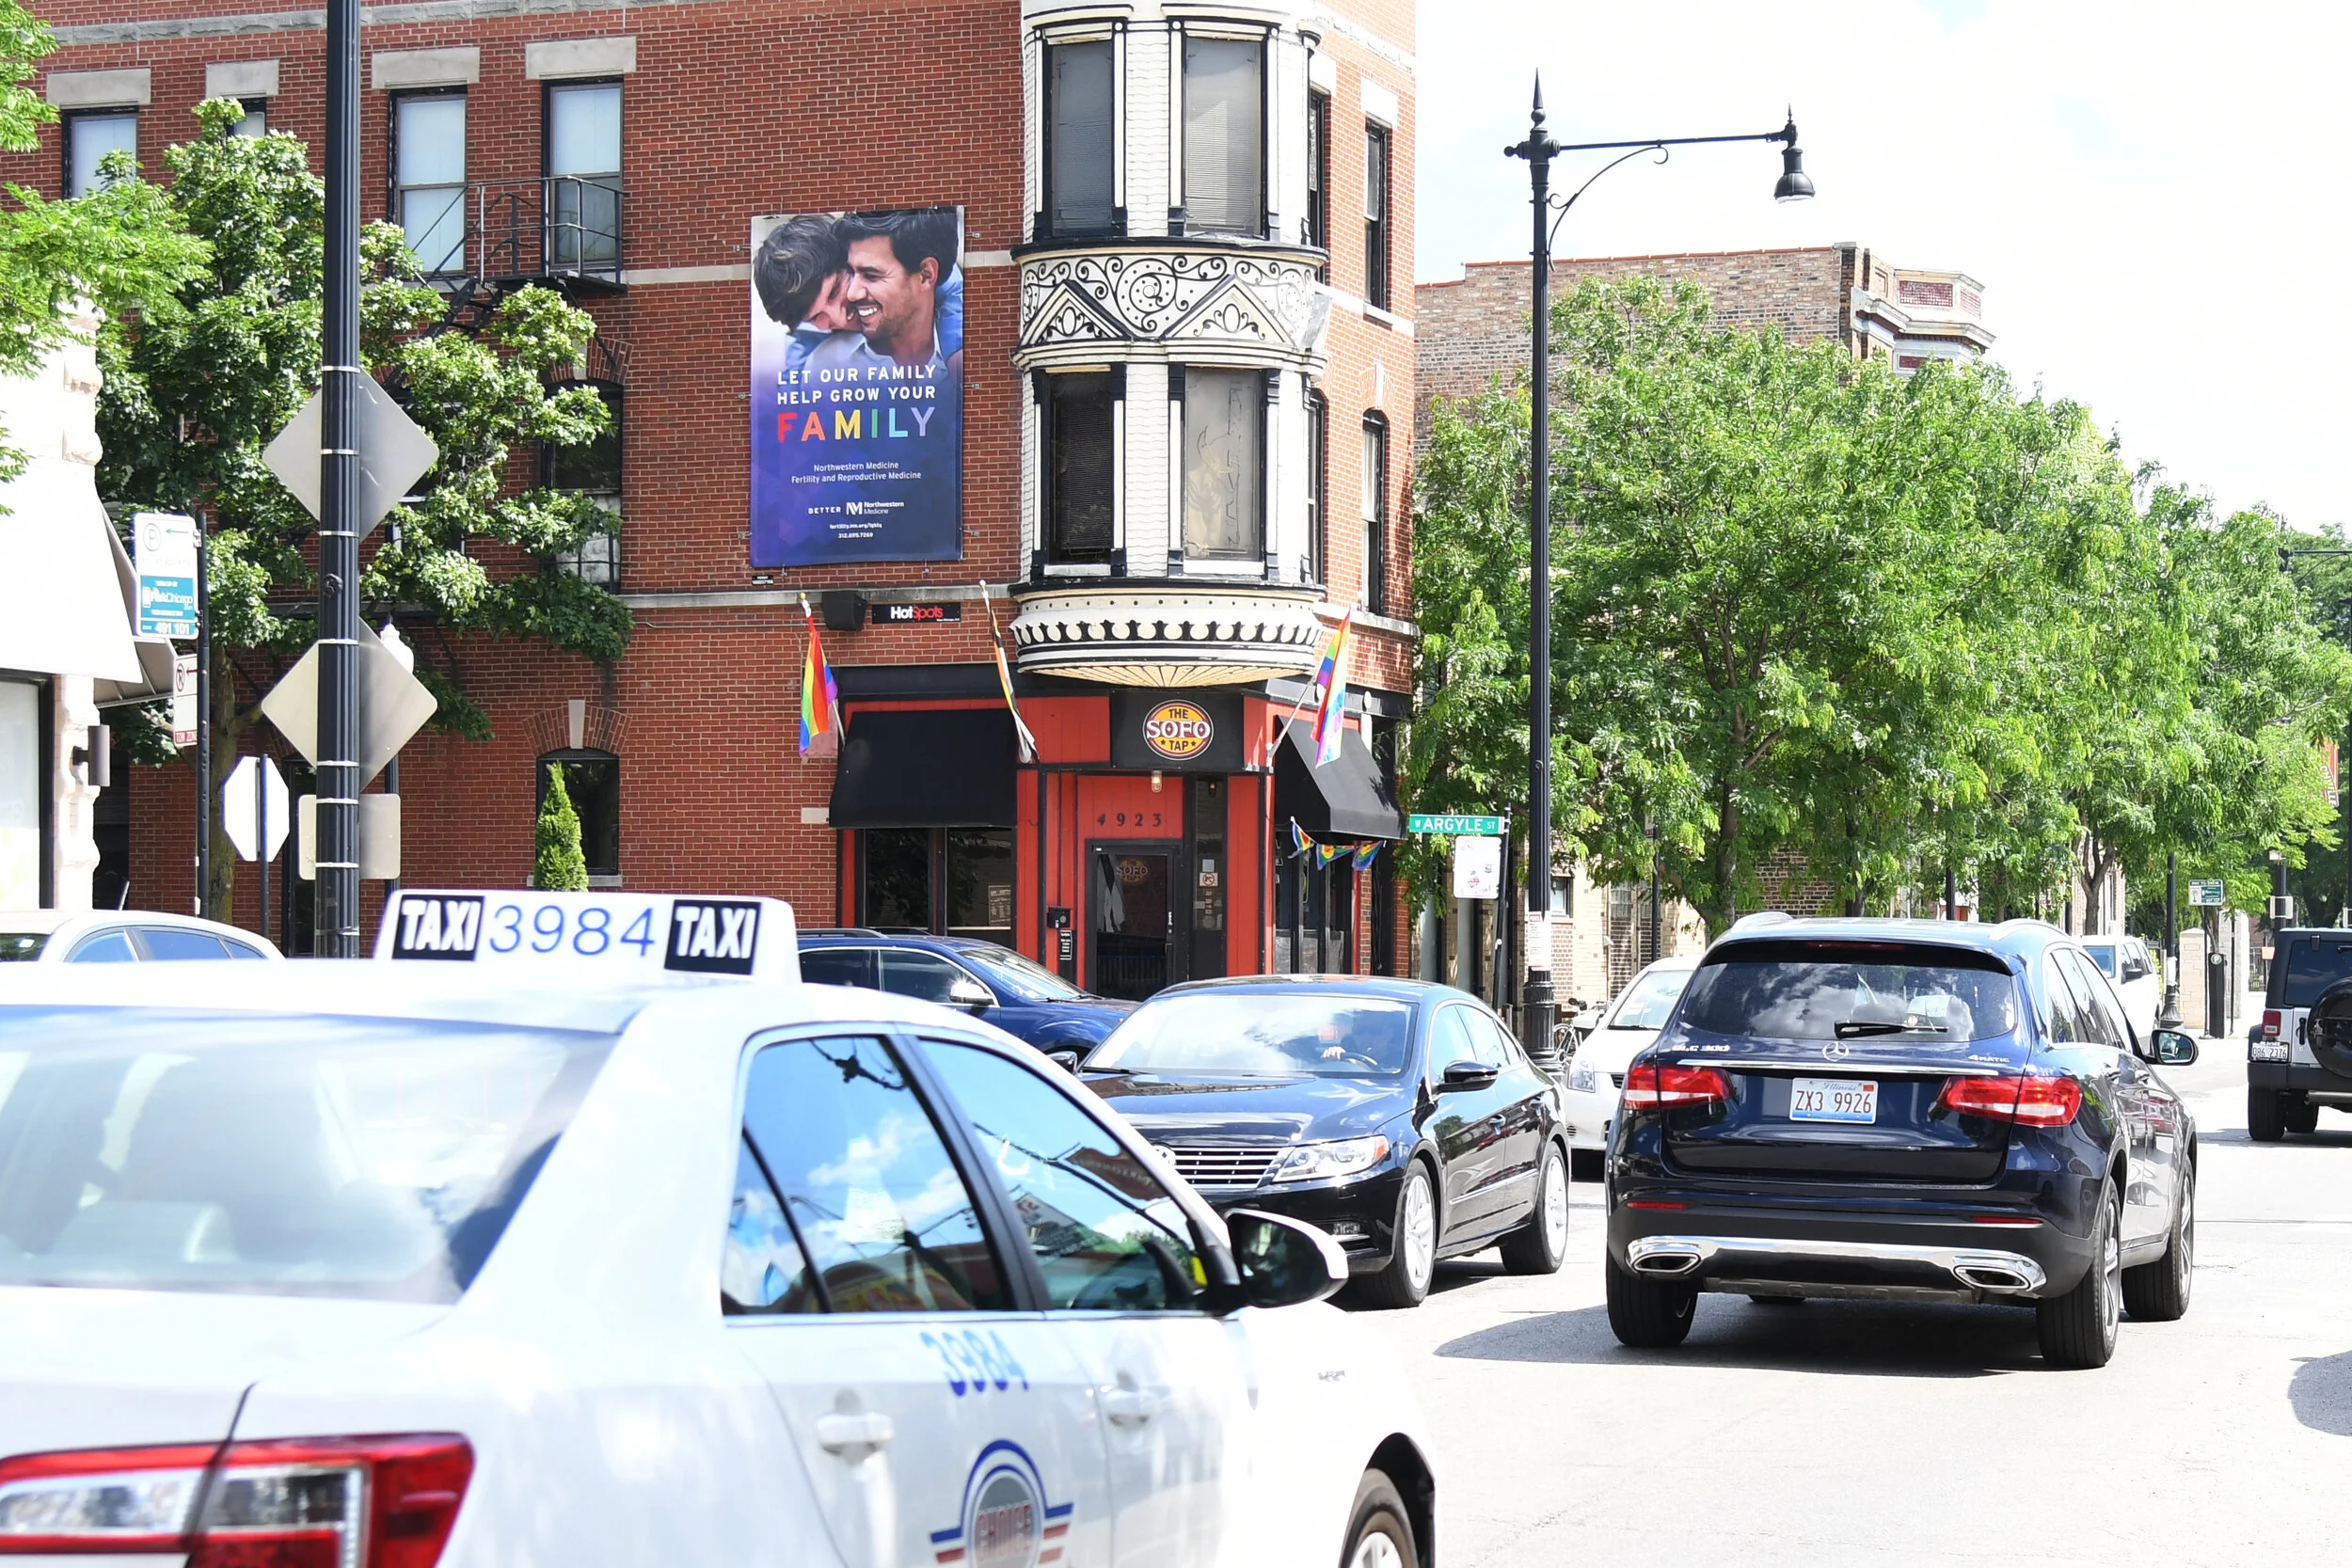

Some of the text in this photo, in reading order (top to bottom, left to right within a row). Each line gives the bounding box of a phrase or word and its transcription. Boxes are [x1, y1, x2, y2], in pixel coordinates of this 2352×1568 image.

[777, 365, 936, 385] LET OUR FAMILY
[777, 386, 935, 404] HELP GROW YOUR
[777, 406, 935, 443] FAMILY
[814, 461, 898, 472] Northwestern Medicine
[791, 471, 922, 483] Fertility and Reproductive Medicine
[808, 506, 841, 515] BETTER
[890, 605, 944, 621] HotSpots
[1168, 708, 1189, 720] THE
[1147, 720, 1211, 739] SOFO
[1168, 740, 1189, 752] TAP
[1097, 813, 1162, 827] 4923
[1415, 817, 1495, 832] W ARGYLE ST
[1117, 865, 1148, 876] SOFO
[401, 899, 753, 958] TAXI 3984 TAXI
[2269, 1048, 2287, 1058] 2376
[1823, 1082, 1857, 1091] Illinois
[1795, 1090, 1872, 1114] ZX3 9926
[919, 1329, 1029, 1398] 3984
